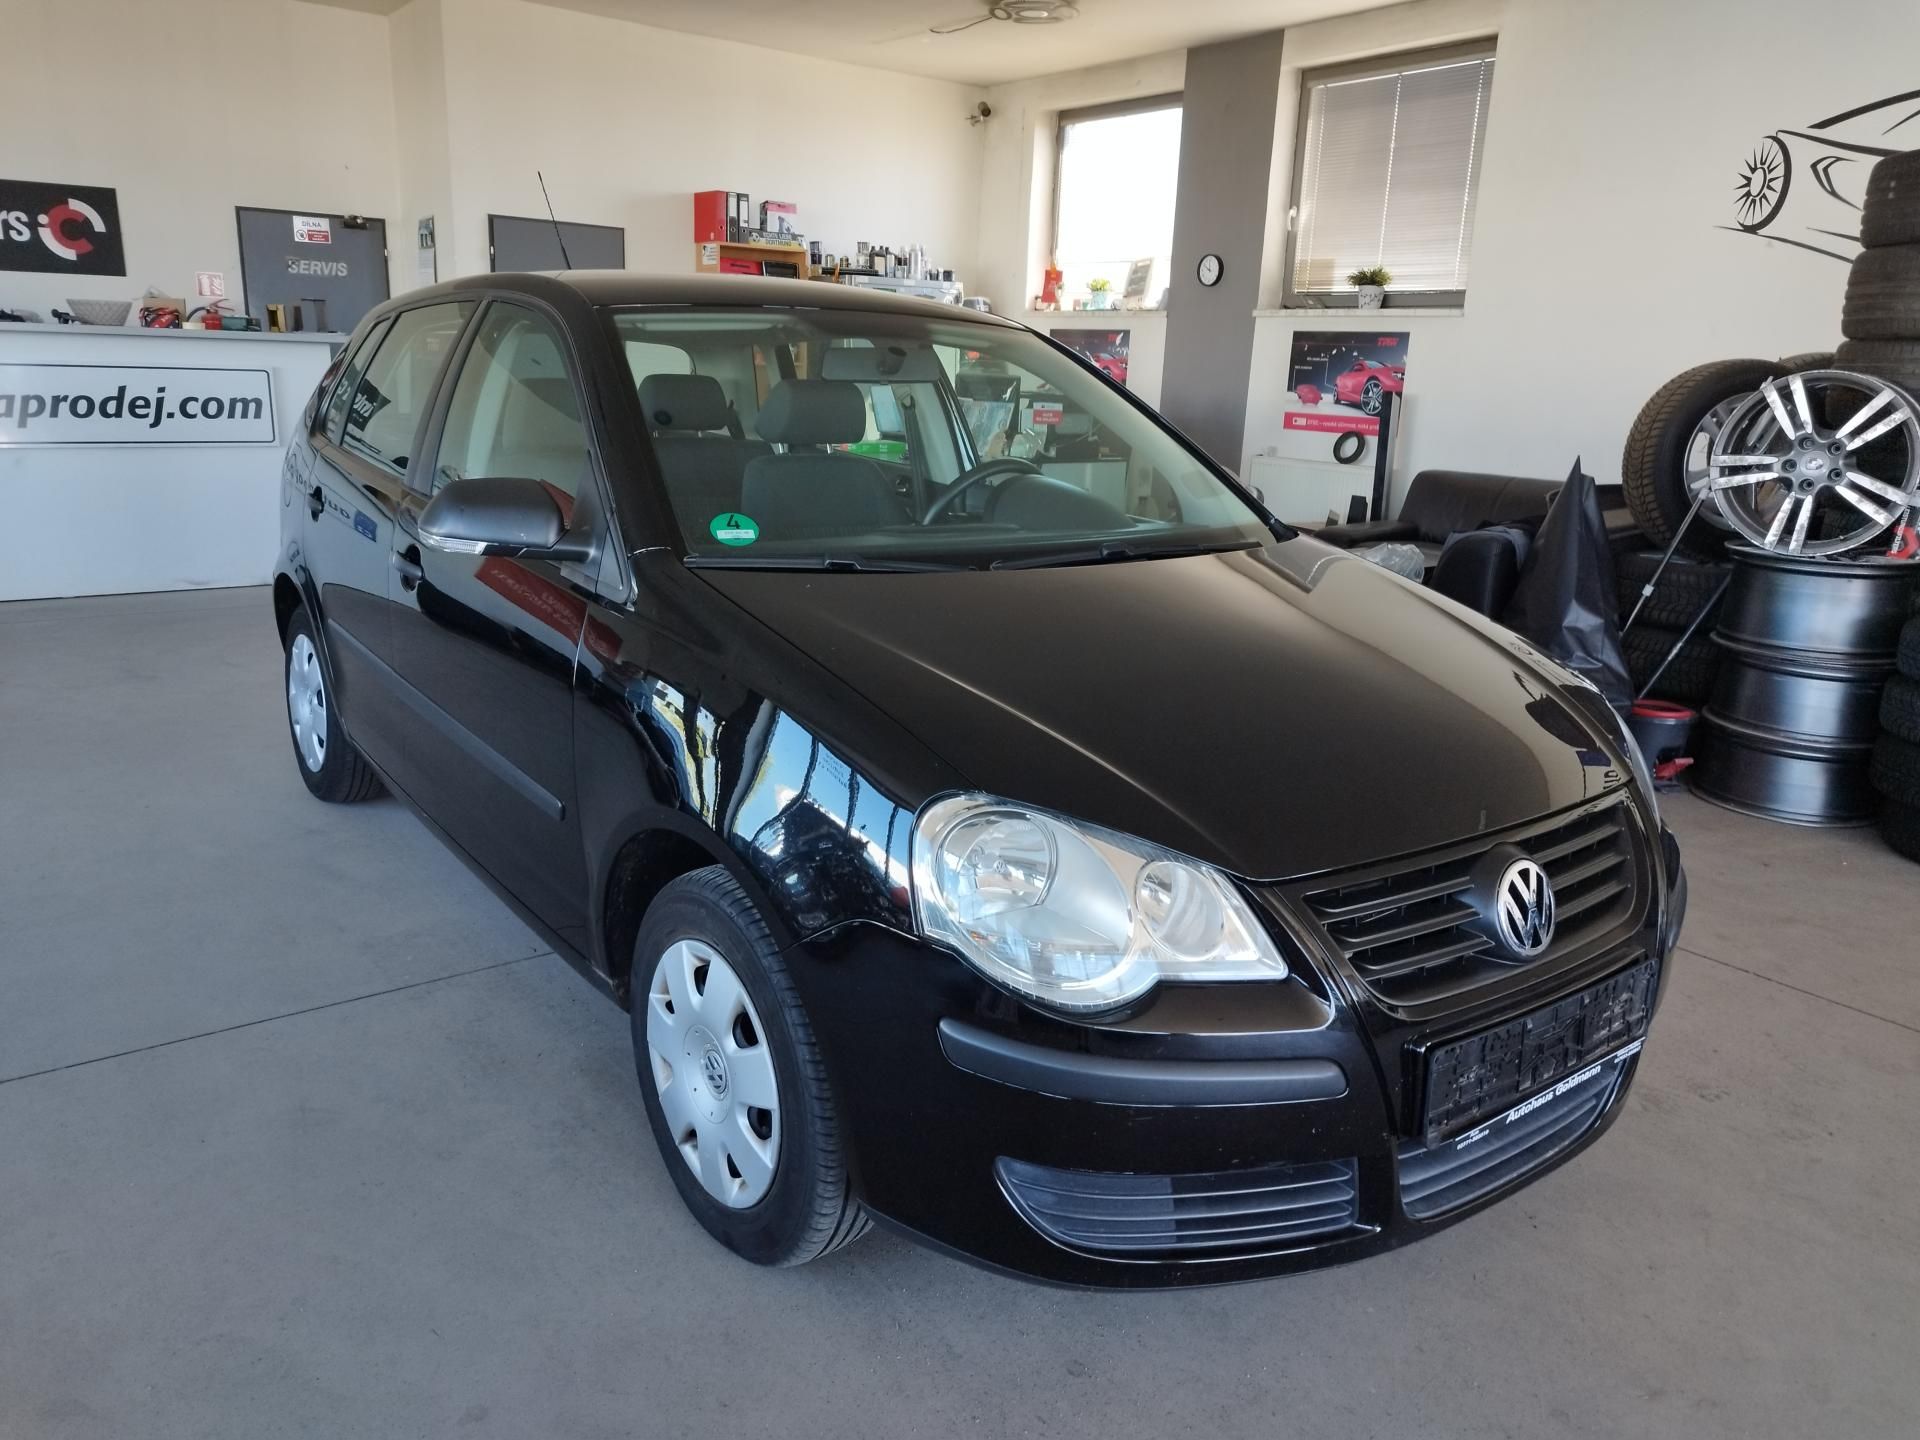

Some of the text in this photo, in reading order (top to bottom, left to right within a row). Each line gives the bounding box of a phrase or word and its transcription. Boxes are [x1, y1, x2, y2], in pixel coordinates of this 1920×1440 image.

[288, 259, 348, 277] SERVIS
[727, 514, 741, 530] 4
[1505, 1065, 1602, 1125] Autohaus Goldmann
